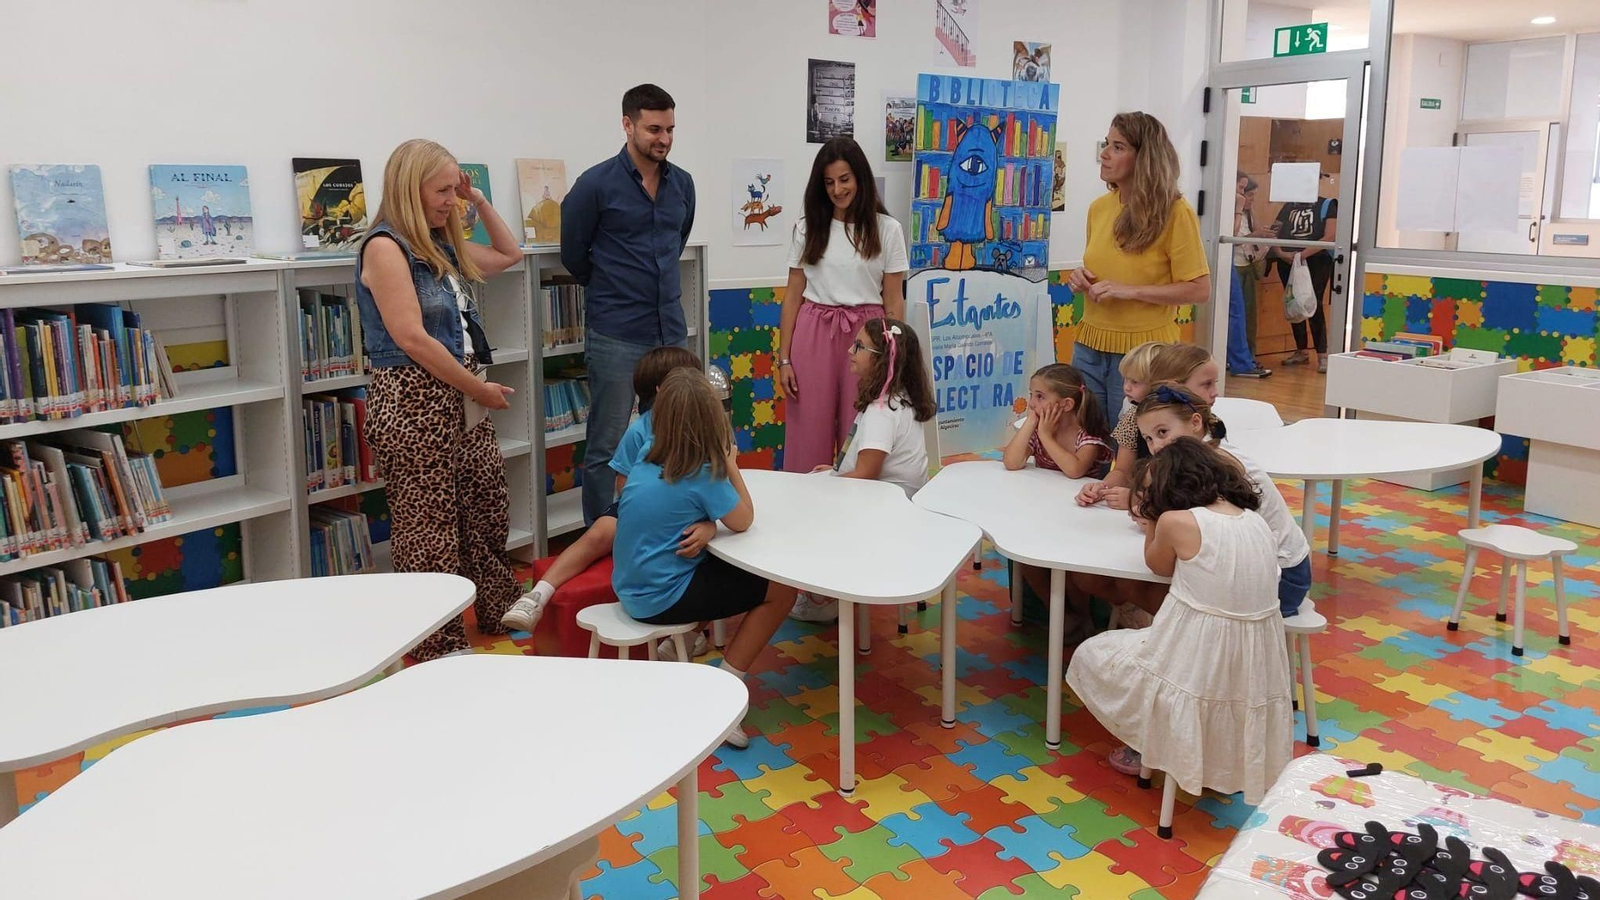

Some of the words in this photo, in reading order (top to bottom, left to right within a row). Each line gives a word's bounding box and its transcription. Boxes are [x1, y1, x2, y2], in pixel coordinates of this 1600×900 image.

[929, 75, 1050, 110] BIBLIOTECA
[171, 172, 189, 182] AL
[193, 172, 232, 182] FINAL
[926, 277, 1021, 330] Estantes
[933, 352, 994, 382] SPACIO
[1002, 351, 1024, 375] DE
[936, 382, 1014, 413] LECTURA
